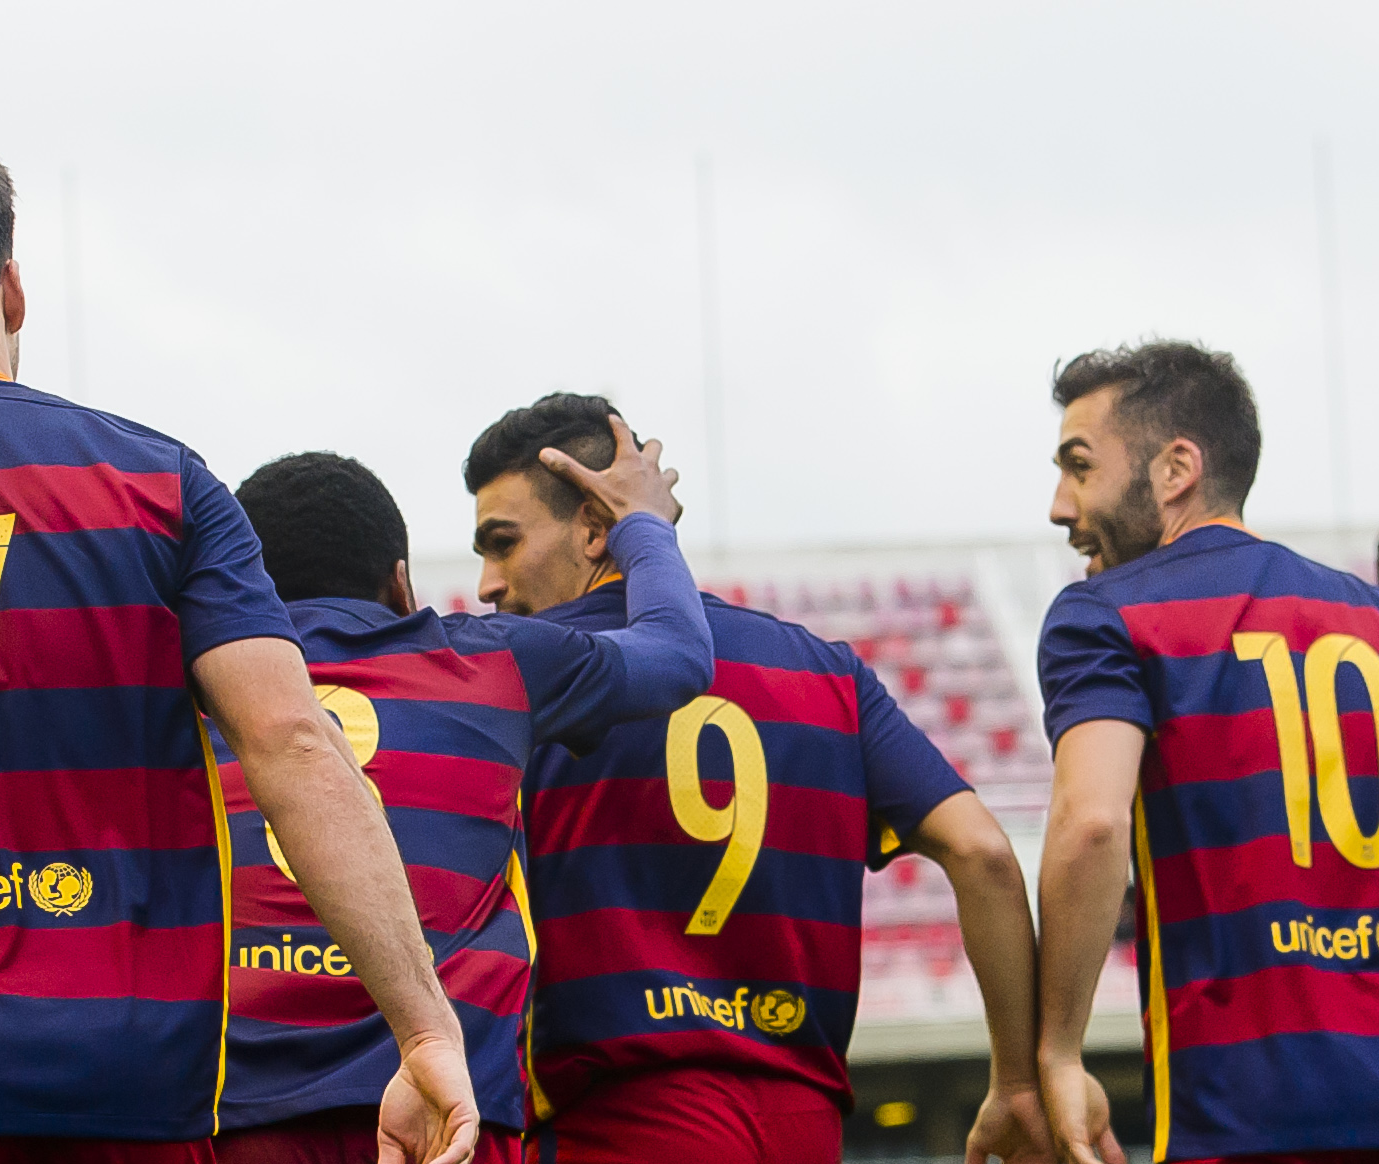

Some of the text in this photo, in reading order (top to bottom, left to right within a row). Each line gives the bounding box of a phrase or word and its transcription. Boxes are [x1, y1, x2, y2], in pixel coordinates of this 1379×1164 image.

[666, 695, 768, 936] 9
[1270, 914, 1373, 960] unicef
[644, 980, 748, 1031] unicef
